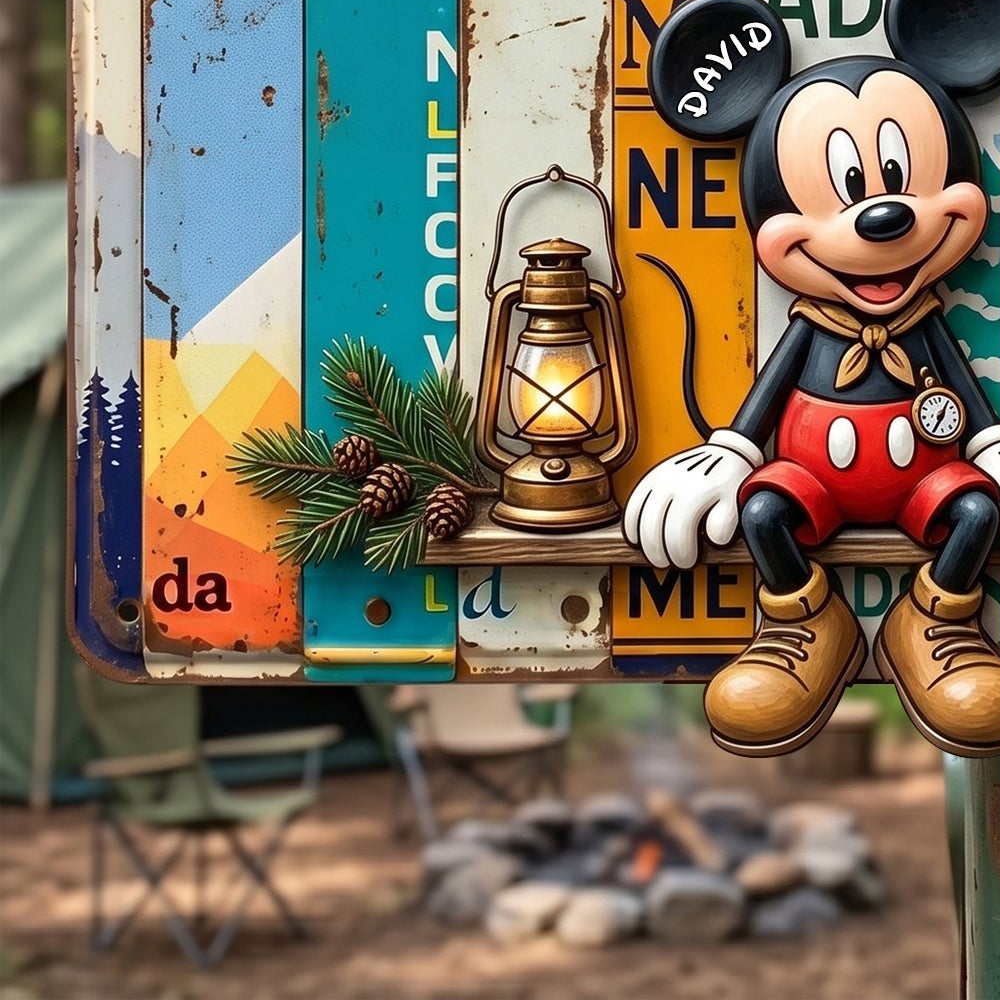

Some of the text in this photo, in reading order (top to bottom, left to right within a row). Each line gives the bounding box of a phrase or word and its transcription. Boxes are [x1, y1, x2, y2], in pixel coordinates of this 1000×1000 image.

[676, 21, 773, 119] DAVID
[628, 147, 737, 229] NE
[151, 556, 233, 613] da
[424, 573, 449, 612] L
